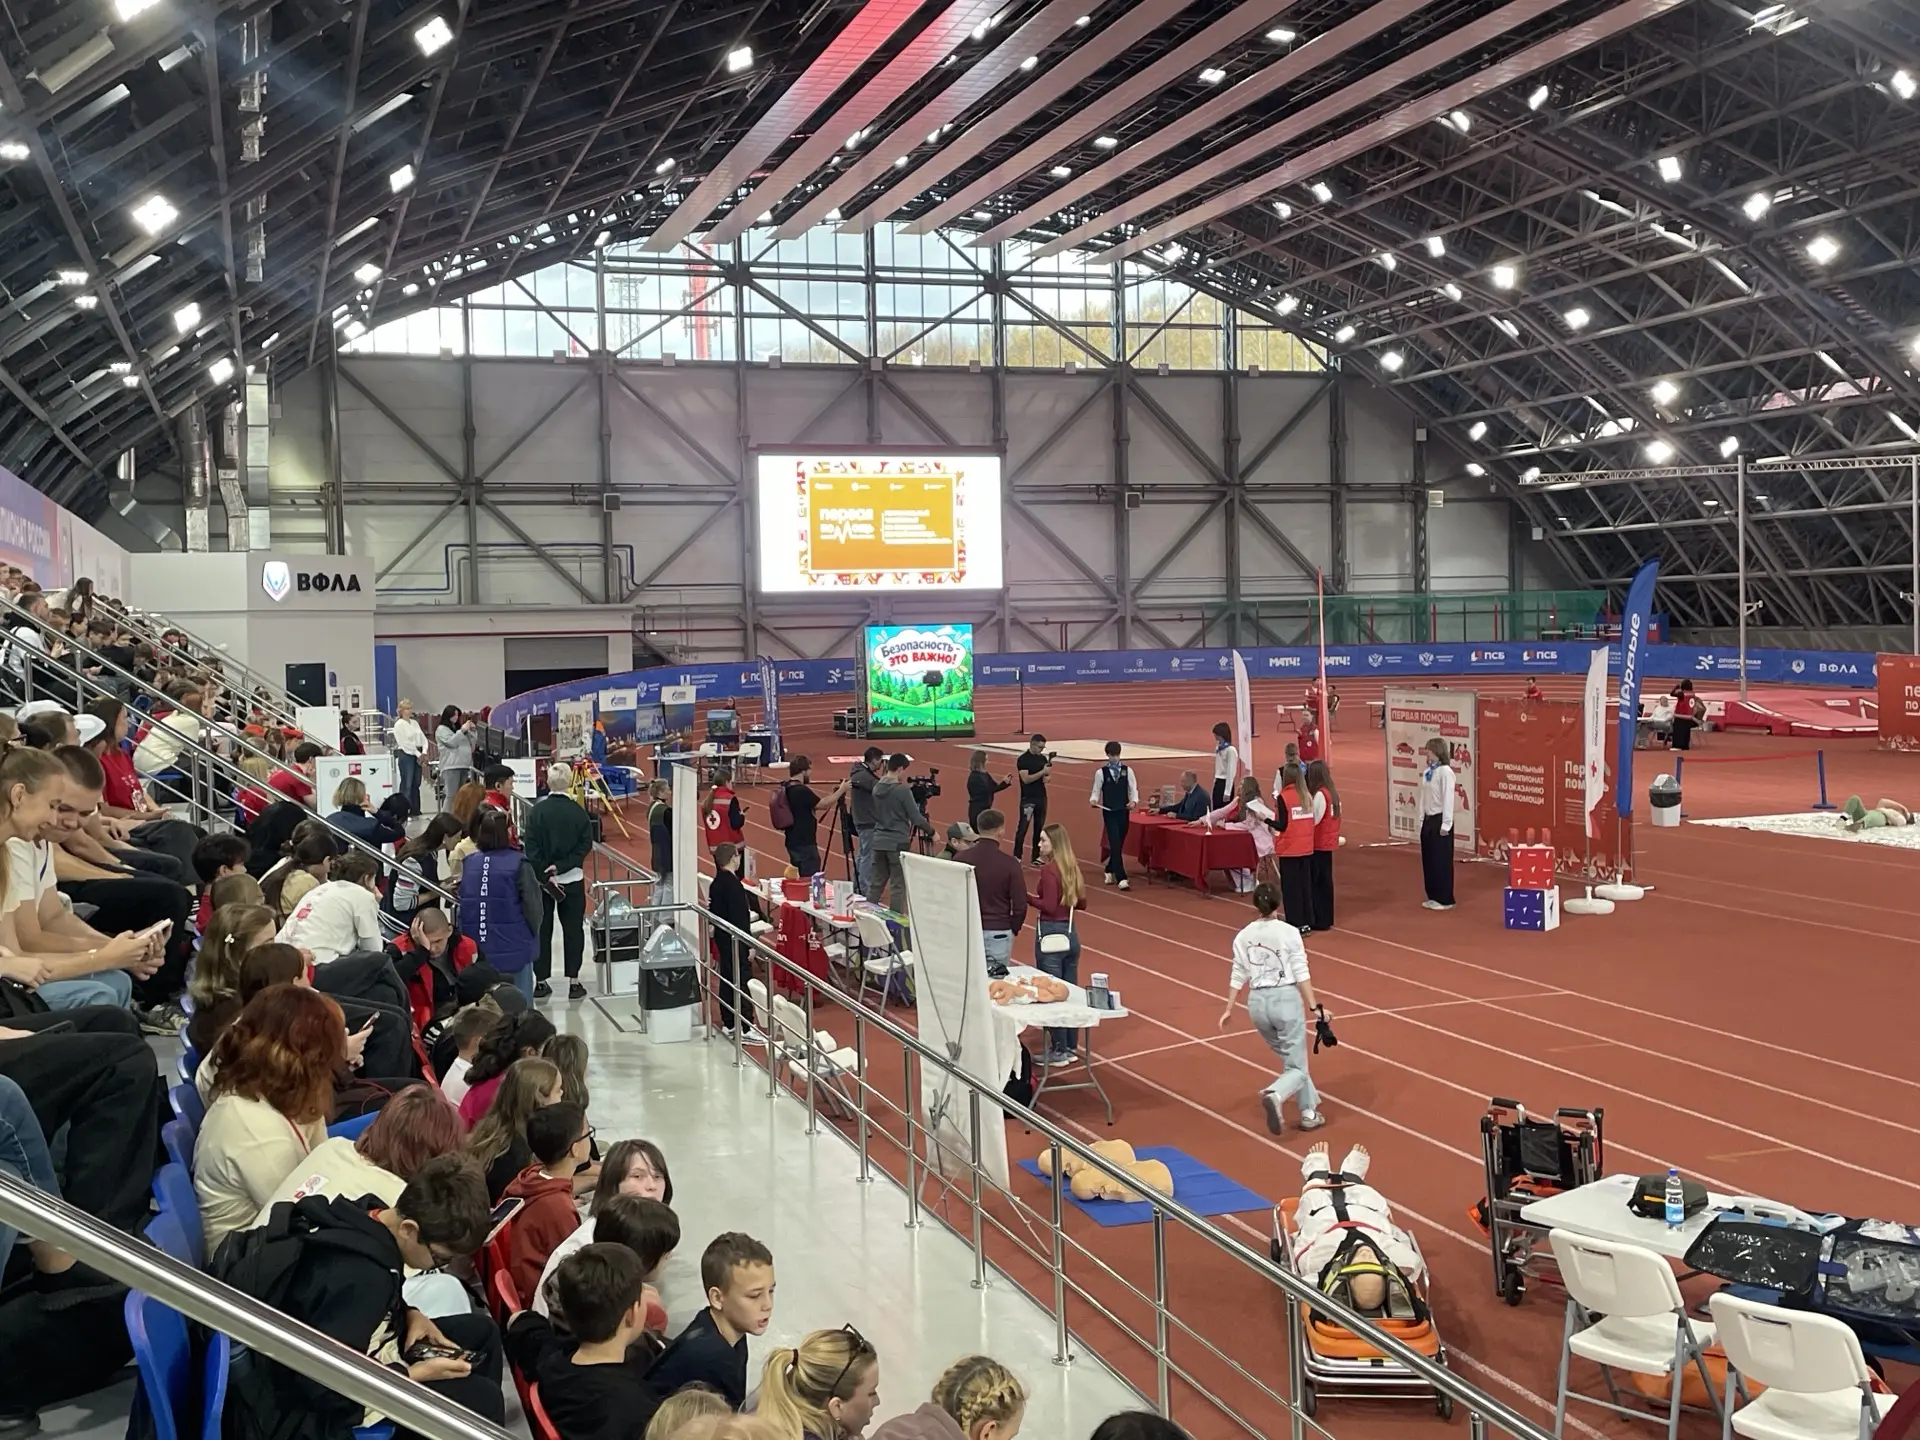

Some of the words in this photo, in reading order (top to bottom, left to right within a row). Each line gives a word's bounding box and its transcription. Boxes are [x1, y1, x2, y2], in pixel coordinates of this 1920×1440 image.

[297, 572, 361, 592] ВФЛА
[880, 640, 954, 658] Безопасность
[1536, 650, 1557, 659] ПСБ
[888, 654, 909, 667] ЭТО
[912, 652, 957, 665] ВАЖНО!
[1269, 656, 1300, 667] МАТЧ!
[1484, 651, 1505, 660] ПСБ
[1819, 663, 1858, 674] ВФЛА
[788, 670, 805, 680] ПСБ
[1392, 710, 1419, 721] ПЕРВАЯ
[1493, 762, 1545, 774] РЕГИОНАЛЬНЫЙ
[1506, 773, 1544, 785] ЧЕМПИОНАТ
[1498, 782, 1508, 790] ПО
[1508, 783, 1545, 795] ОКАЗАНИЮ
[480, 856, 490, 897] ПОХОДЫ
[479, 902, 487, 942] ПЕРВЫХ
